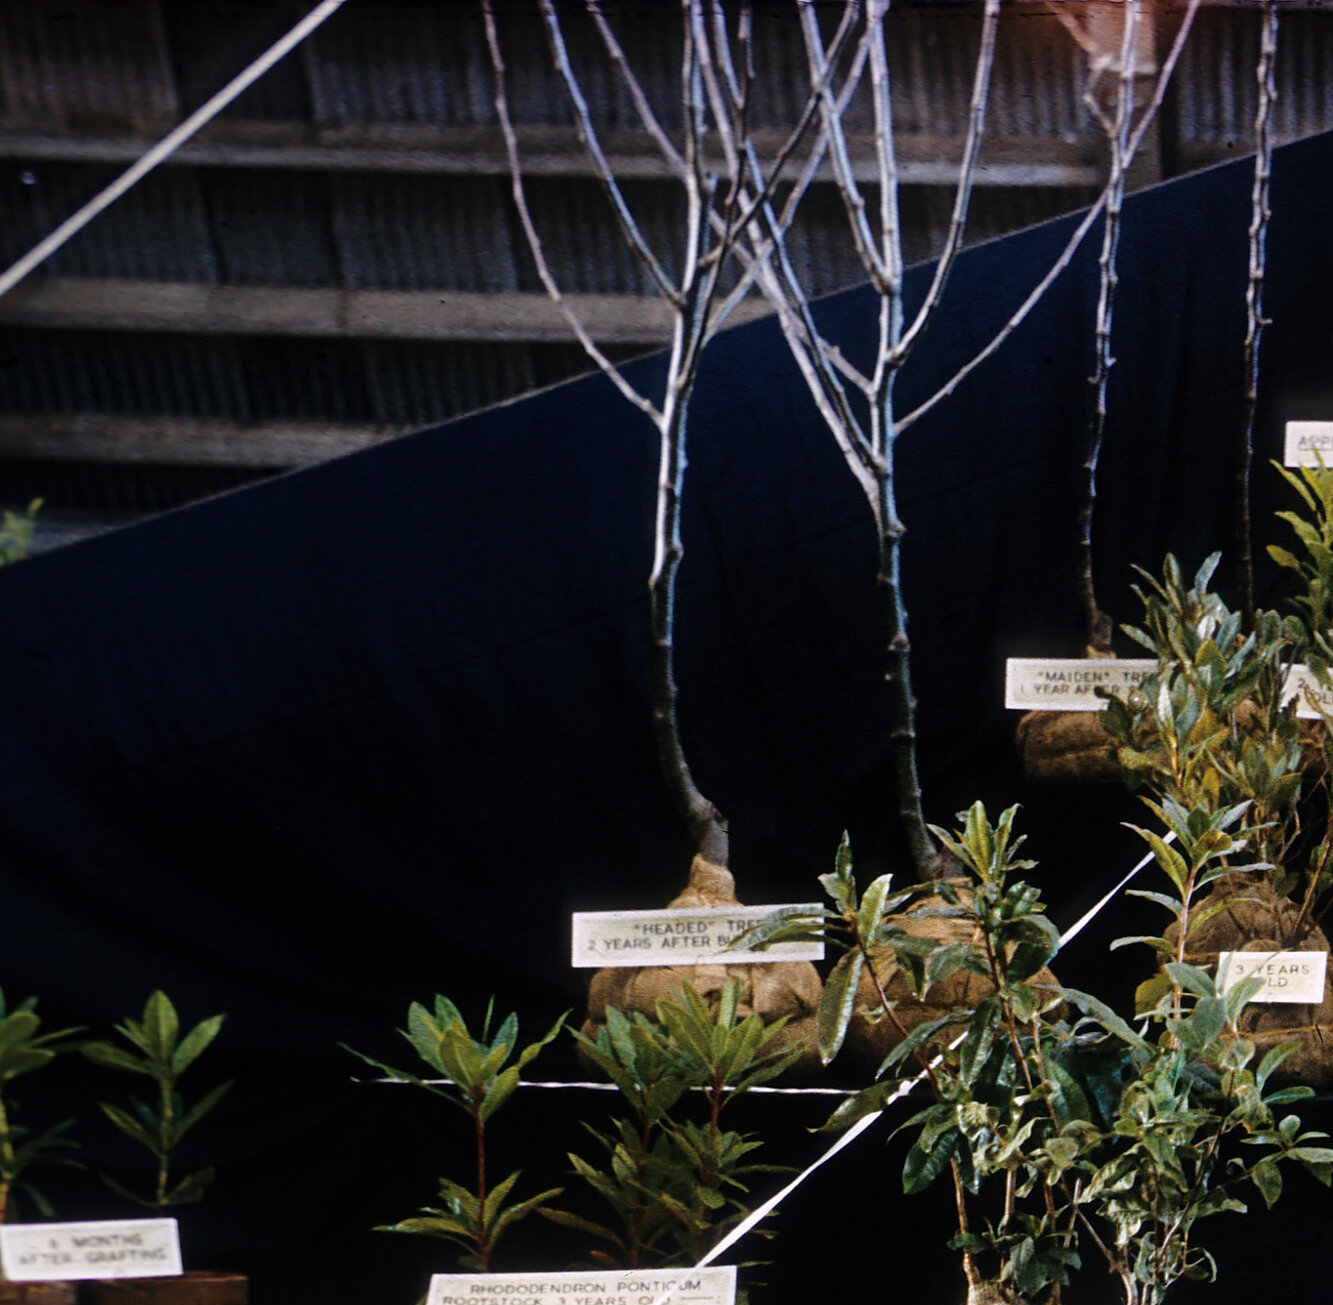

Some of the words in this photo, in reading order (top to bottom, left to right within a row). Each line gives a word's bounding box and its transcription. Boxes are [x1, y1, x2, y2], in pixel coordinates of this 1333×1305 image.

[1034, 684, 1069, 694] YEAR
[1075, 684, 1120, 694] AFER
[634, 920, 715, 936] "HEADED"
[587, 940, 595, 950] 2
[604, 939, 651, 950] YEARS
[661, 937, 710, 949] AFTER
[1235, 965, 1244, 974] 3
[1256, 964, 1311, 975] YEARS
[72, 1234, 142, 1247] MONTHS
[86, 1248, 166, 1263] GRAFTING
[470, 1283, 605, 1295] RHODODENDRON
